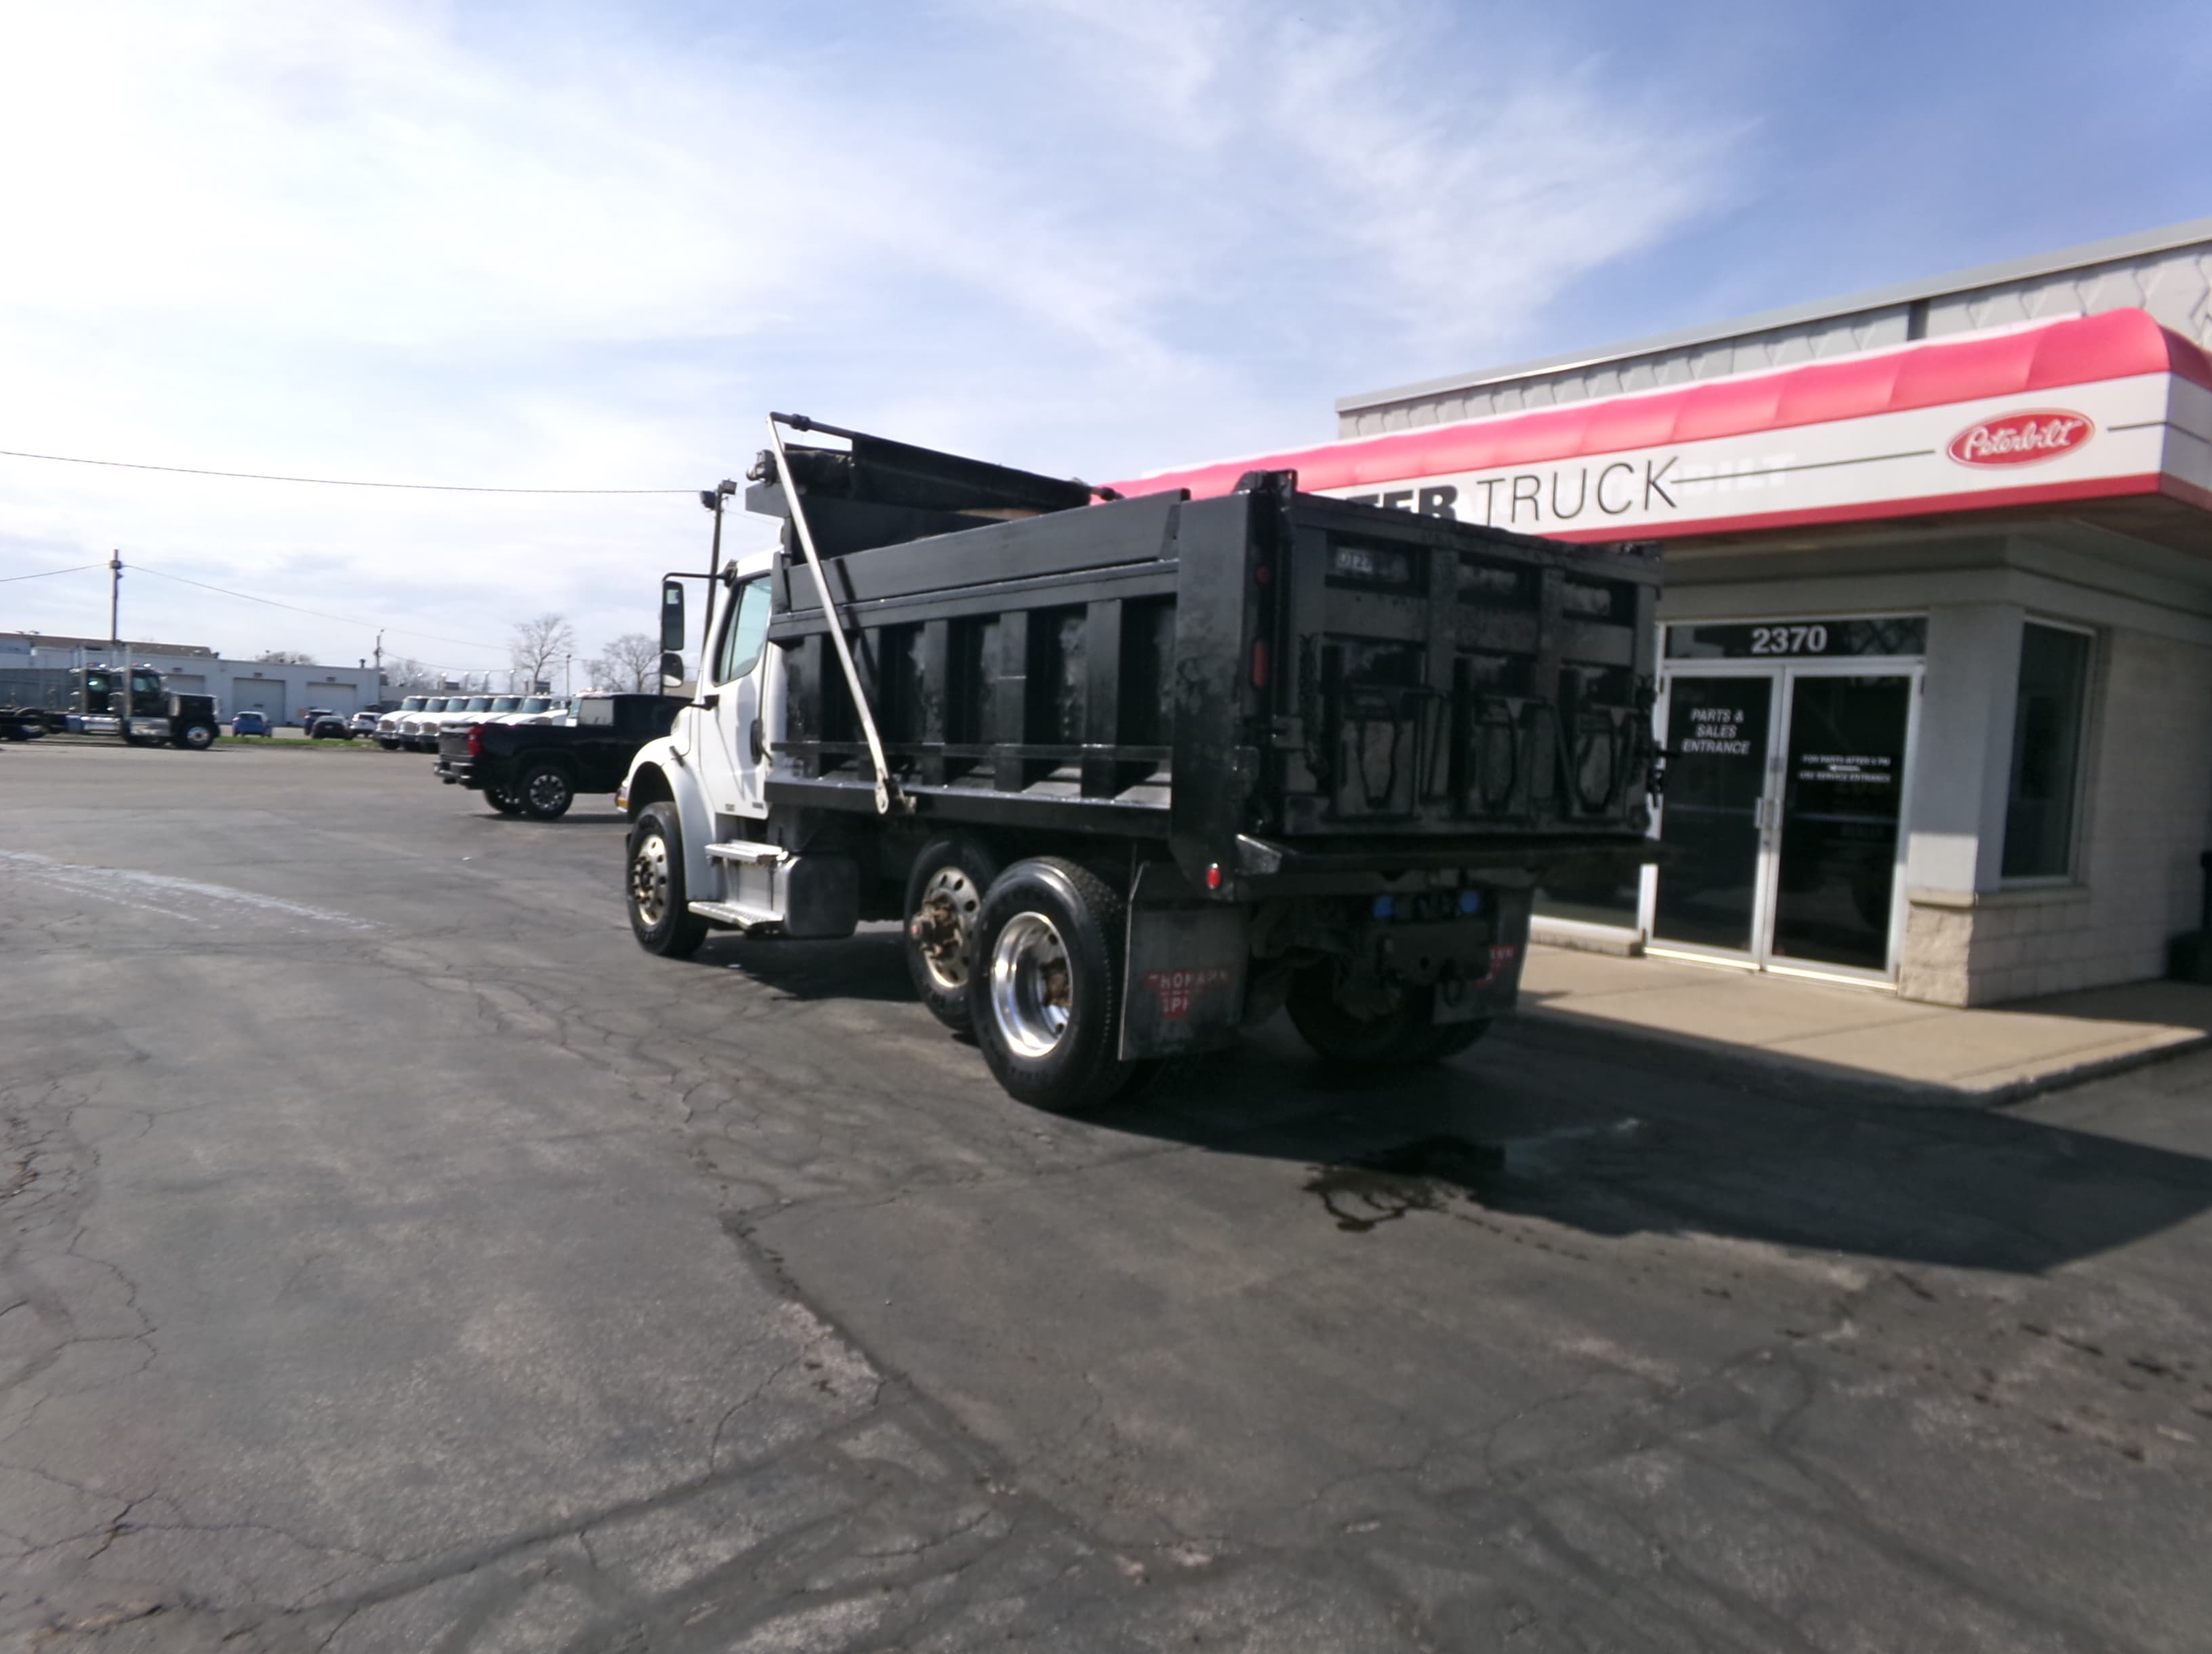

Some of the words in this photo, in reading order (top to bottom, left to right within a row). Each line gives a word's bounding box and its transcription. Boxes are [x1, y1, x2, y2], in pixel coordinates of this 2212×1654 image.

[1964, 418, 2085, 460] Peterbilt
[1476, 456, 1679, 527] TRUCK
[1752, 625, 1828, 654] 2370
[1690, 708, 1732, 723] PARTS
[1734, 709, 1744, 723] &
[1696, 723, 1737, 738] SALES
[1682, 738, 1751, 755] ENTRANCE
[1820, 755, 1844, 764] PARTS
[1845, 756, 1870, 765] AFTER
[1816, 772, 1848, 781] SERVICE
[1849, 773, 1891, 782] ENTRANCE
